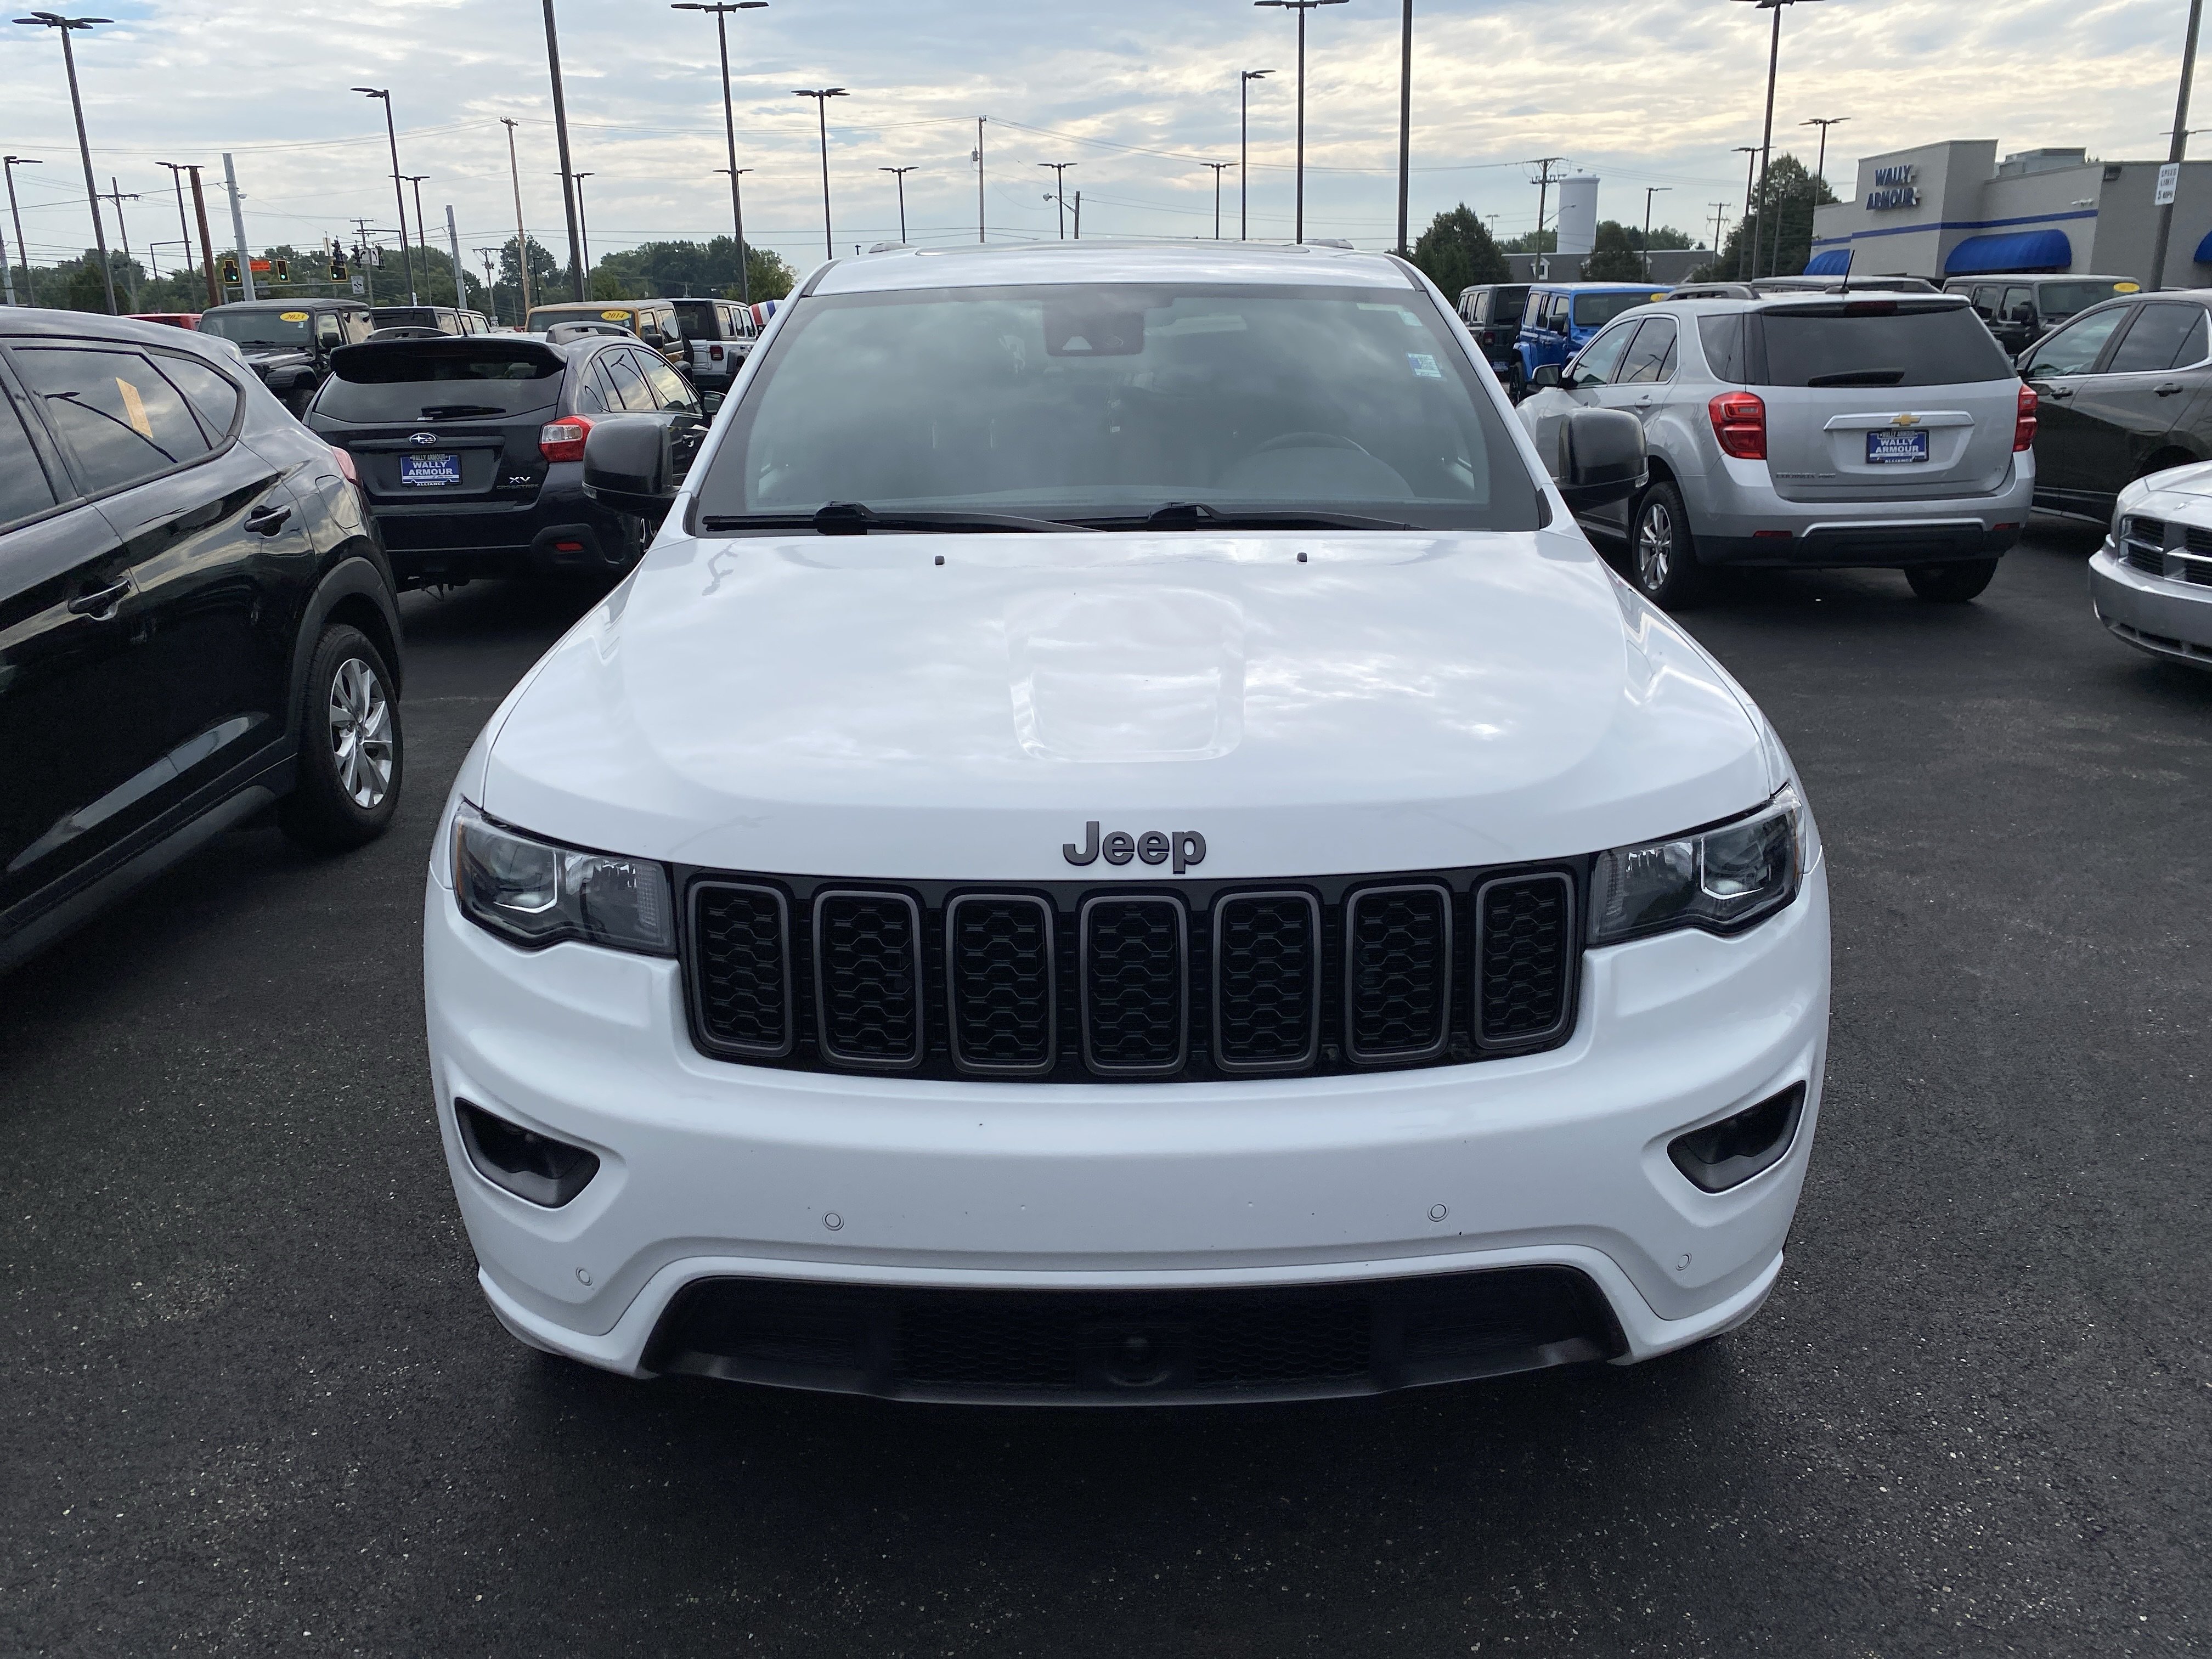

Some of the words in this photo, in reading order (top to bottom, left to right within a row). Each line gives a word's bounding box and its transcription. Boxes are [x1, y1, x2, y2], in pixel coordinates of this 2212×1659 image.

[1875, 165, 1914, 187] WALLY
[2160, 178, 2175, 186] LIMIT
[2162, 168, 2177, 178] SPEED
[1866, 187, 1917, 210] ARMOUR
[1063, 821, 1206, 874] Jeep
